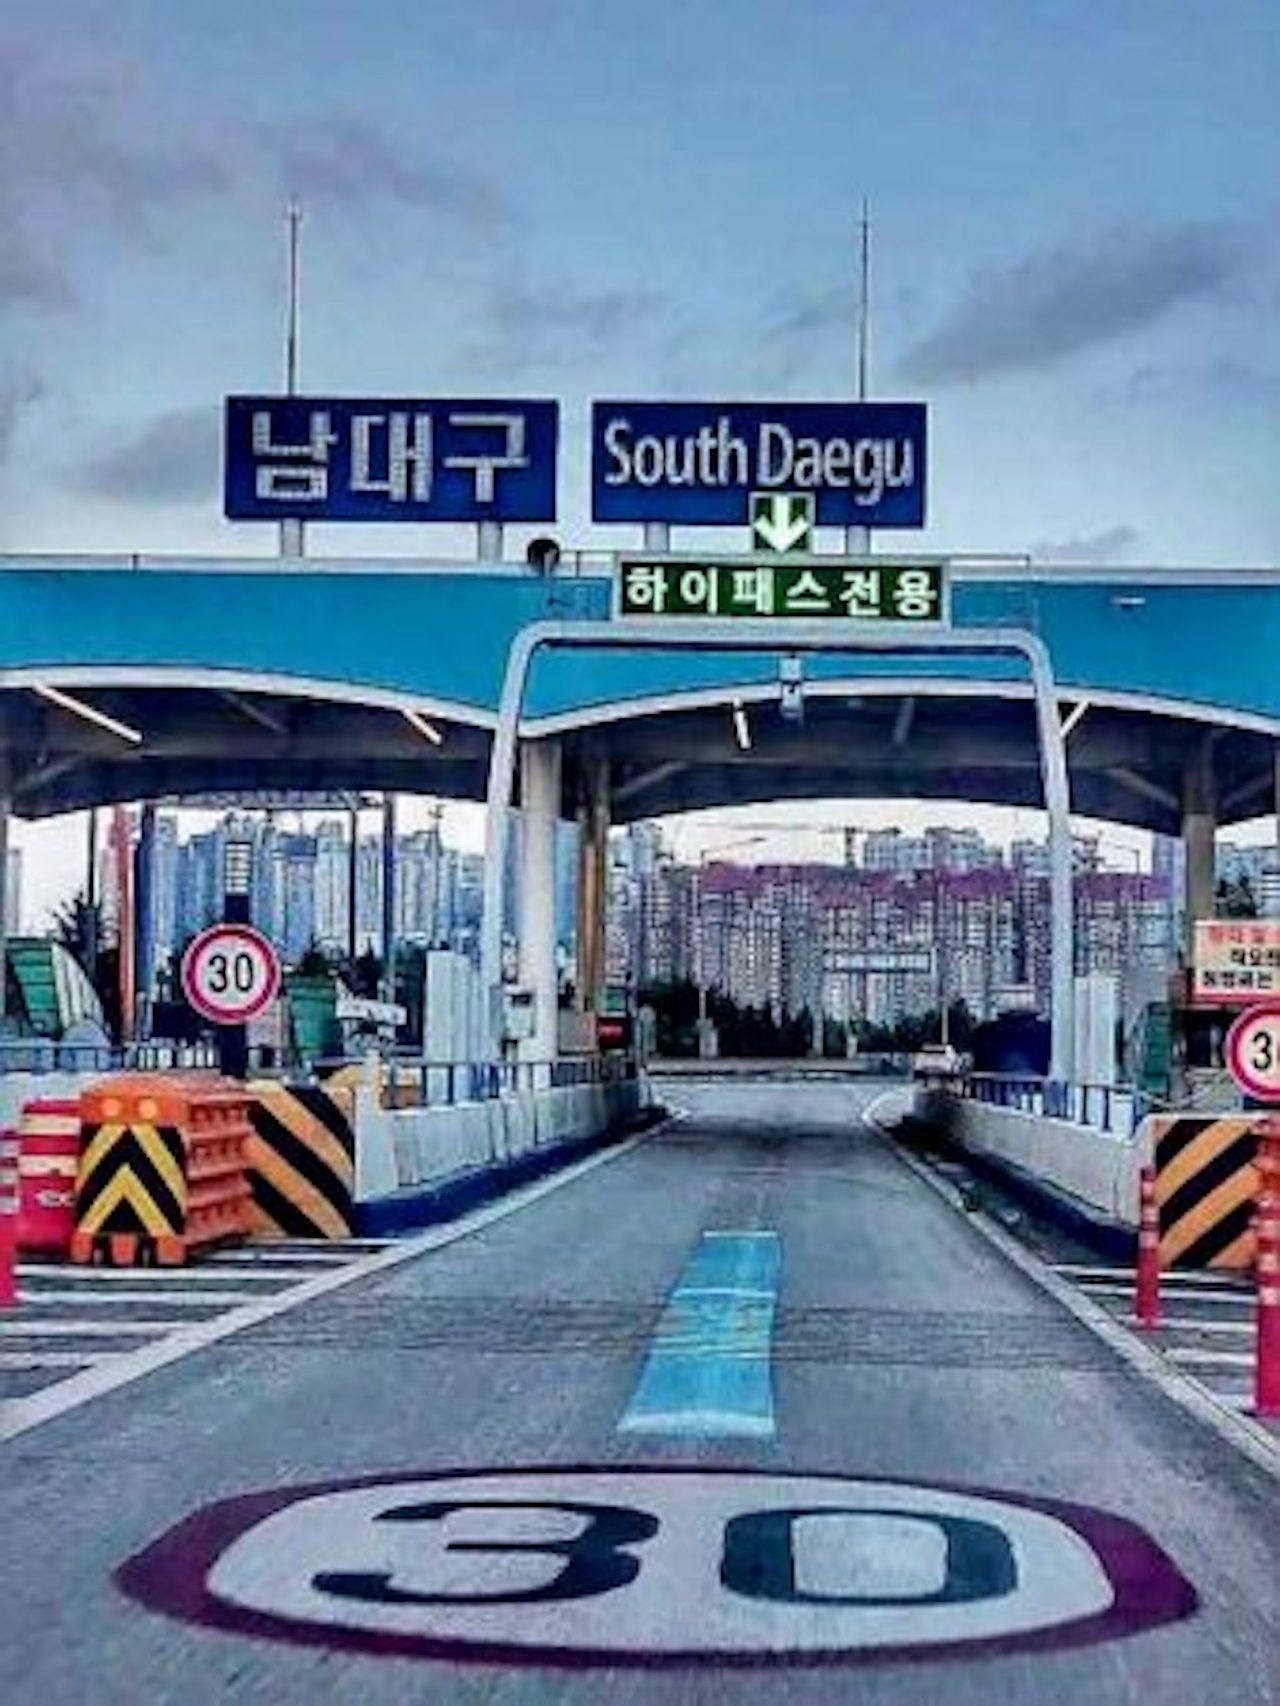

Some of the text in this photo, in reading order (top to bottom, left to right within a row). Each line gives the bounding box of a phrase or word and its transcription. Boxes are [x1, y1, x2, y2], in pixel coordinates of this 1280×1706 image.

[251, 411, 530, 502] 남대구
[604, 417, 913, 507] South Daegu
[626, 567, 939, 618] 하이패스전용
[207, 953, 254, 993] 30
[1252, 1031, 1280, 1071] 3
[311, 1501, 1018, 1606] 30
